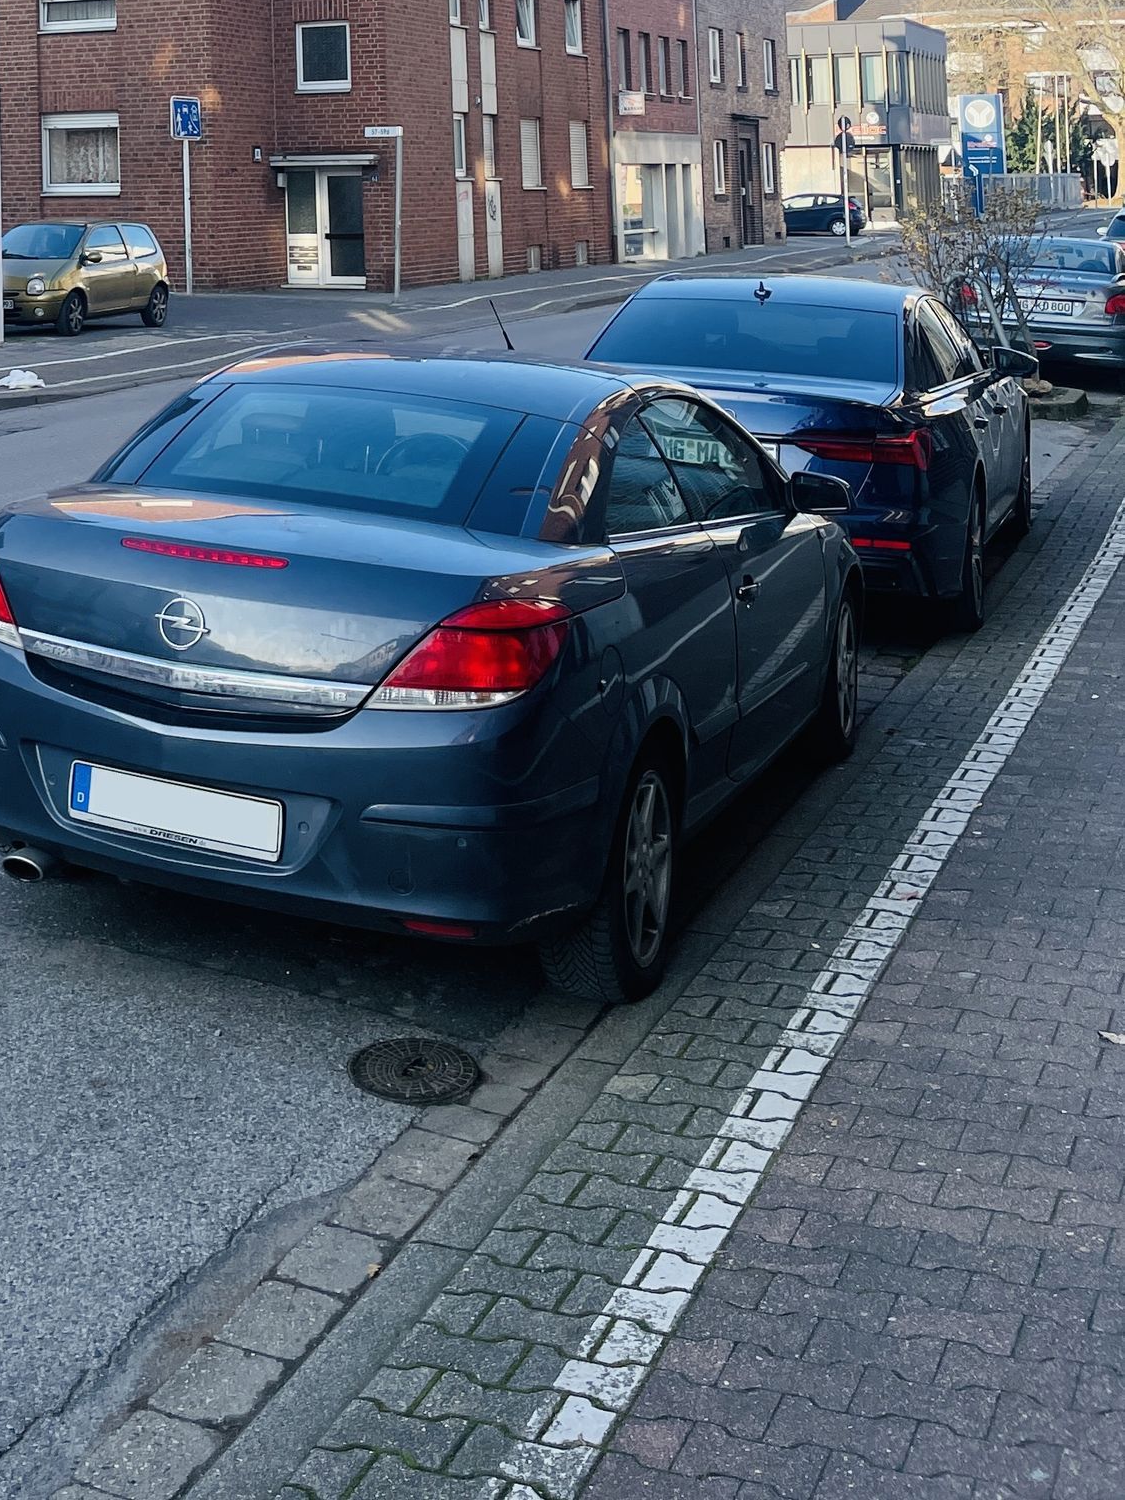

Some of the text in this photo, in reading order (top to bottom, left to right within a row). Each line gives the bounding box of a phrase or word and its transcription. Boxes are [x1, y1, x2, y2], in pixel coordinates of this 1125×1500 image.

[1051, 302, 1071, 312] 800
[663, 438, 685, 460] MG
[696, 441, 720, 463] MA
[33, 640, 74, 659] ASTRA
[77, 791, 85, 803] D
